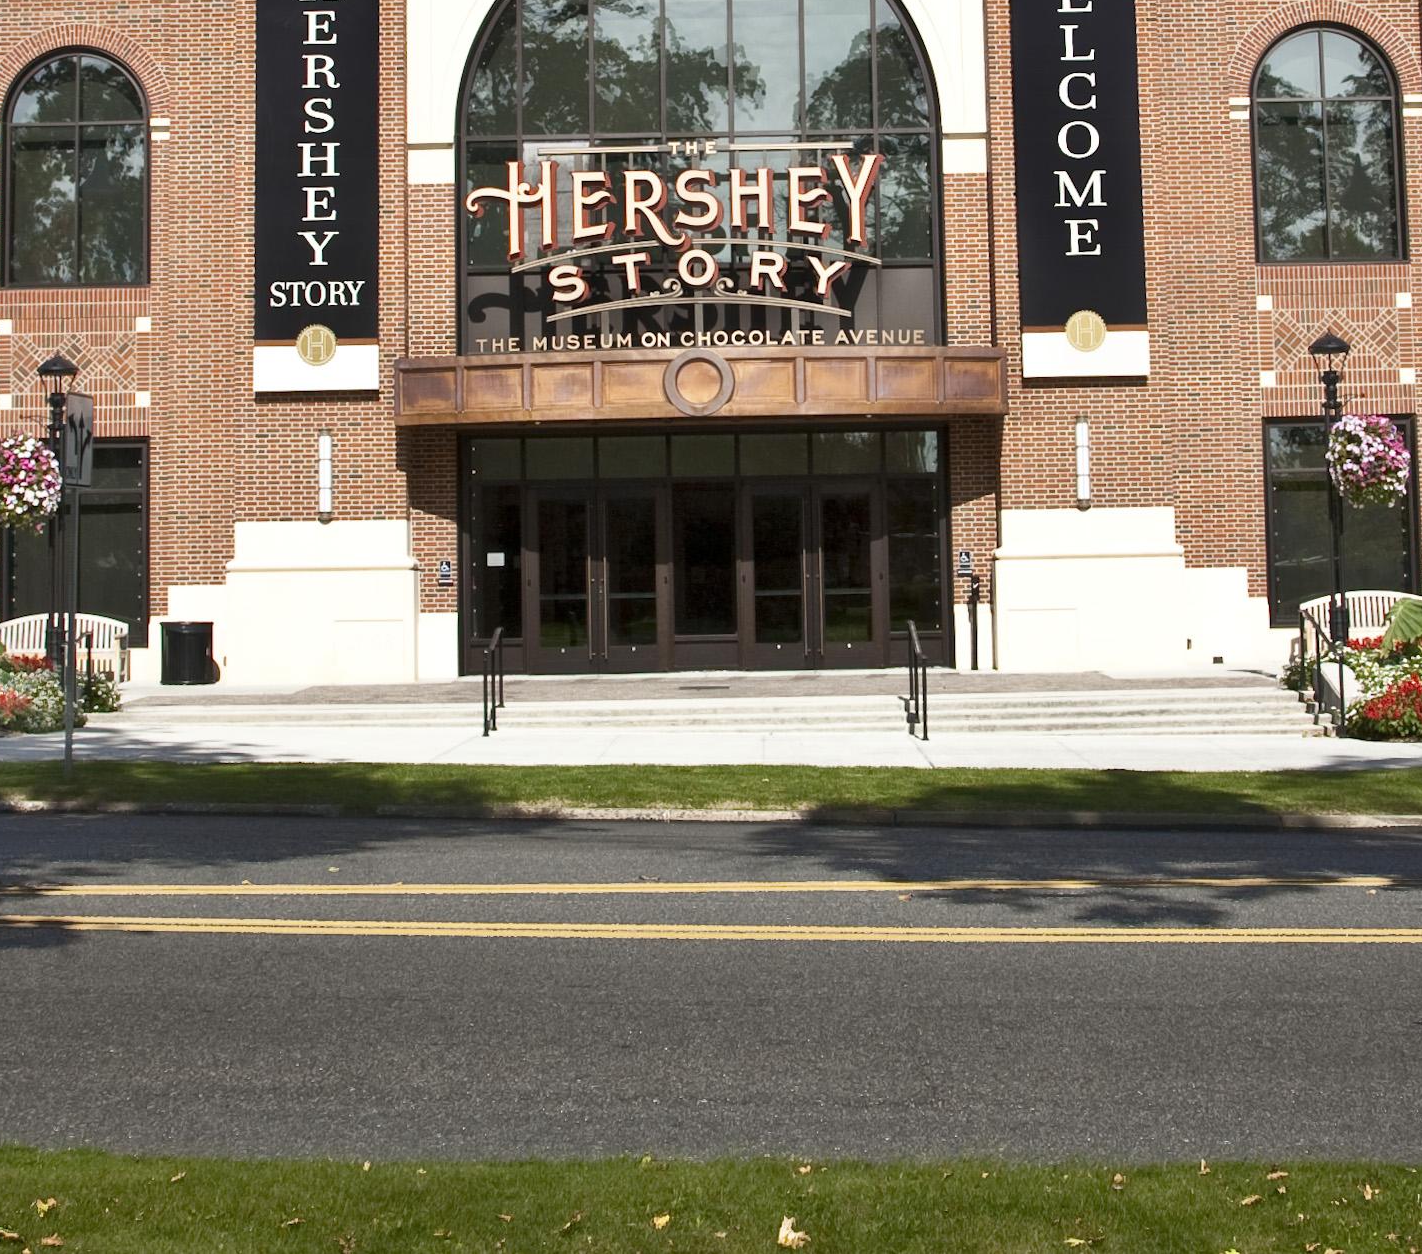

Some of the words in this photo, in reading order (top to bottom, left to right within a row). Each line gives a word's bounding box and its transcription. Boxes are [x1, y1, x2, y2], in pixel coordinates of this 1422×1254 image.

[667, 140, 718, 156] THE
[466, 154, 885, 263] HERSHEY
[547, 248, 851, 304] STORY
[269, 281, 365, 308] STORY
[475, 337, 521, 354] THE
[532, 332, 633, 352] MUSEUM
[640, 331, 672, 348] ON
[680, 329, 826, 347] CHOCOLATE
[834, 328, 926, 346] AVENUE
